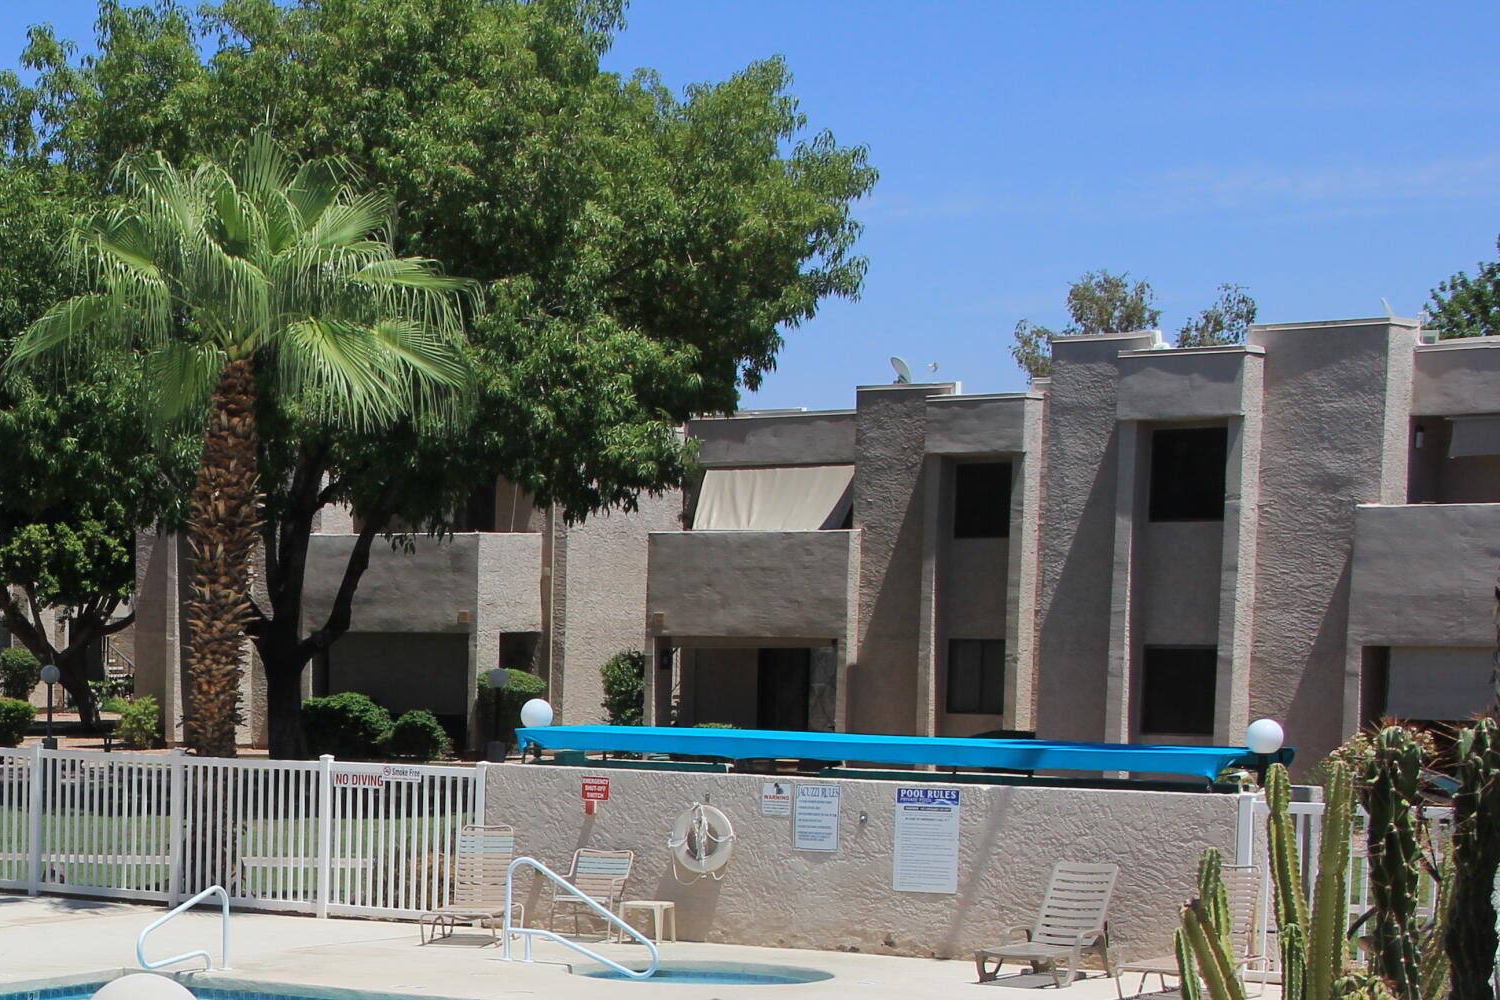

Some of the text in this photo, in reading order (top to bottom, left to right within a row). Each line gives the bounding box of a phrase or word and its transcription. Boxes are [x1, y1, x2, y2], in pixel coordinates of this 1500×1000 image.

[336, 774, 348, 785] NO
[352, 774, 384, 787] DIVING
[900, 789, 957, 799] POOL RULES
